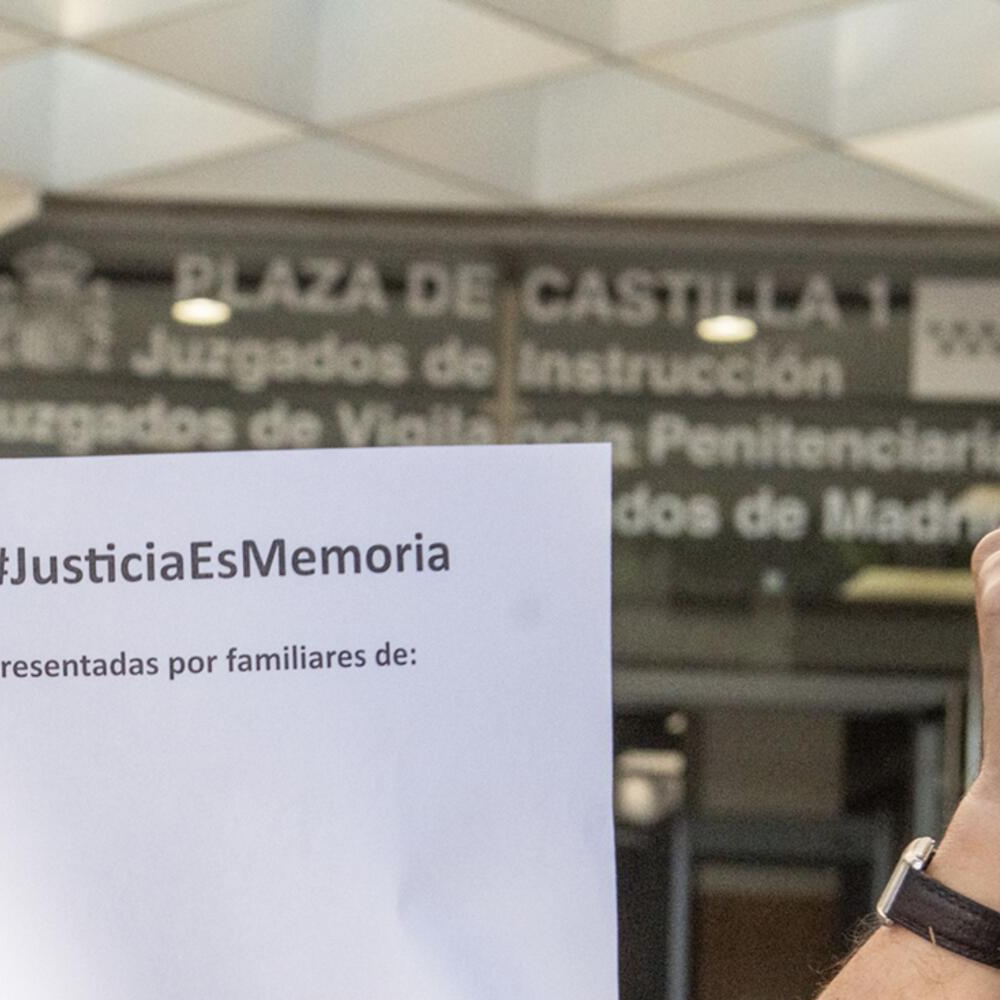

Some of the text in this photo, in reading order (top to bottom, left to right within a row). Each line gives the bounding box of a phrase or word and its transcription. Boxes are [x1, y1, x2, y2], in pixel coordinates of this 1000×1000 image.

[173, 253, 389, 316] PLAZA
[405, 260, 494, 322] DE
[131, 323, 846, 396] Juzgados de Instrucción
[247, 398, 323, 447] de
[647, 411, 1000, 474] Penitenciari
[733, 484, 810, 541] de
[168, 654, 218, 681] por
[225, 644, 367, 673] familiares
[374, 640, 417, 667] de:
